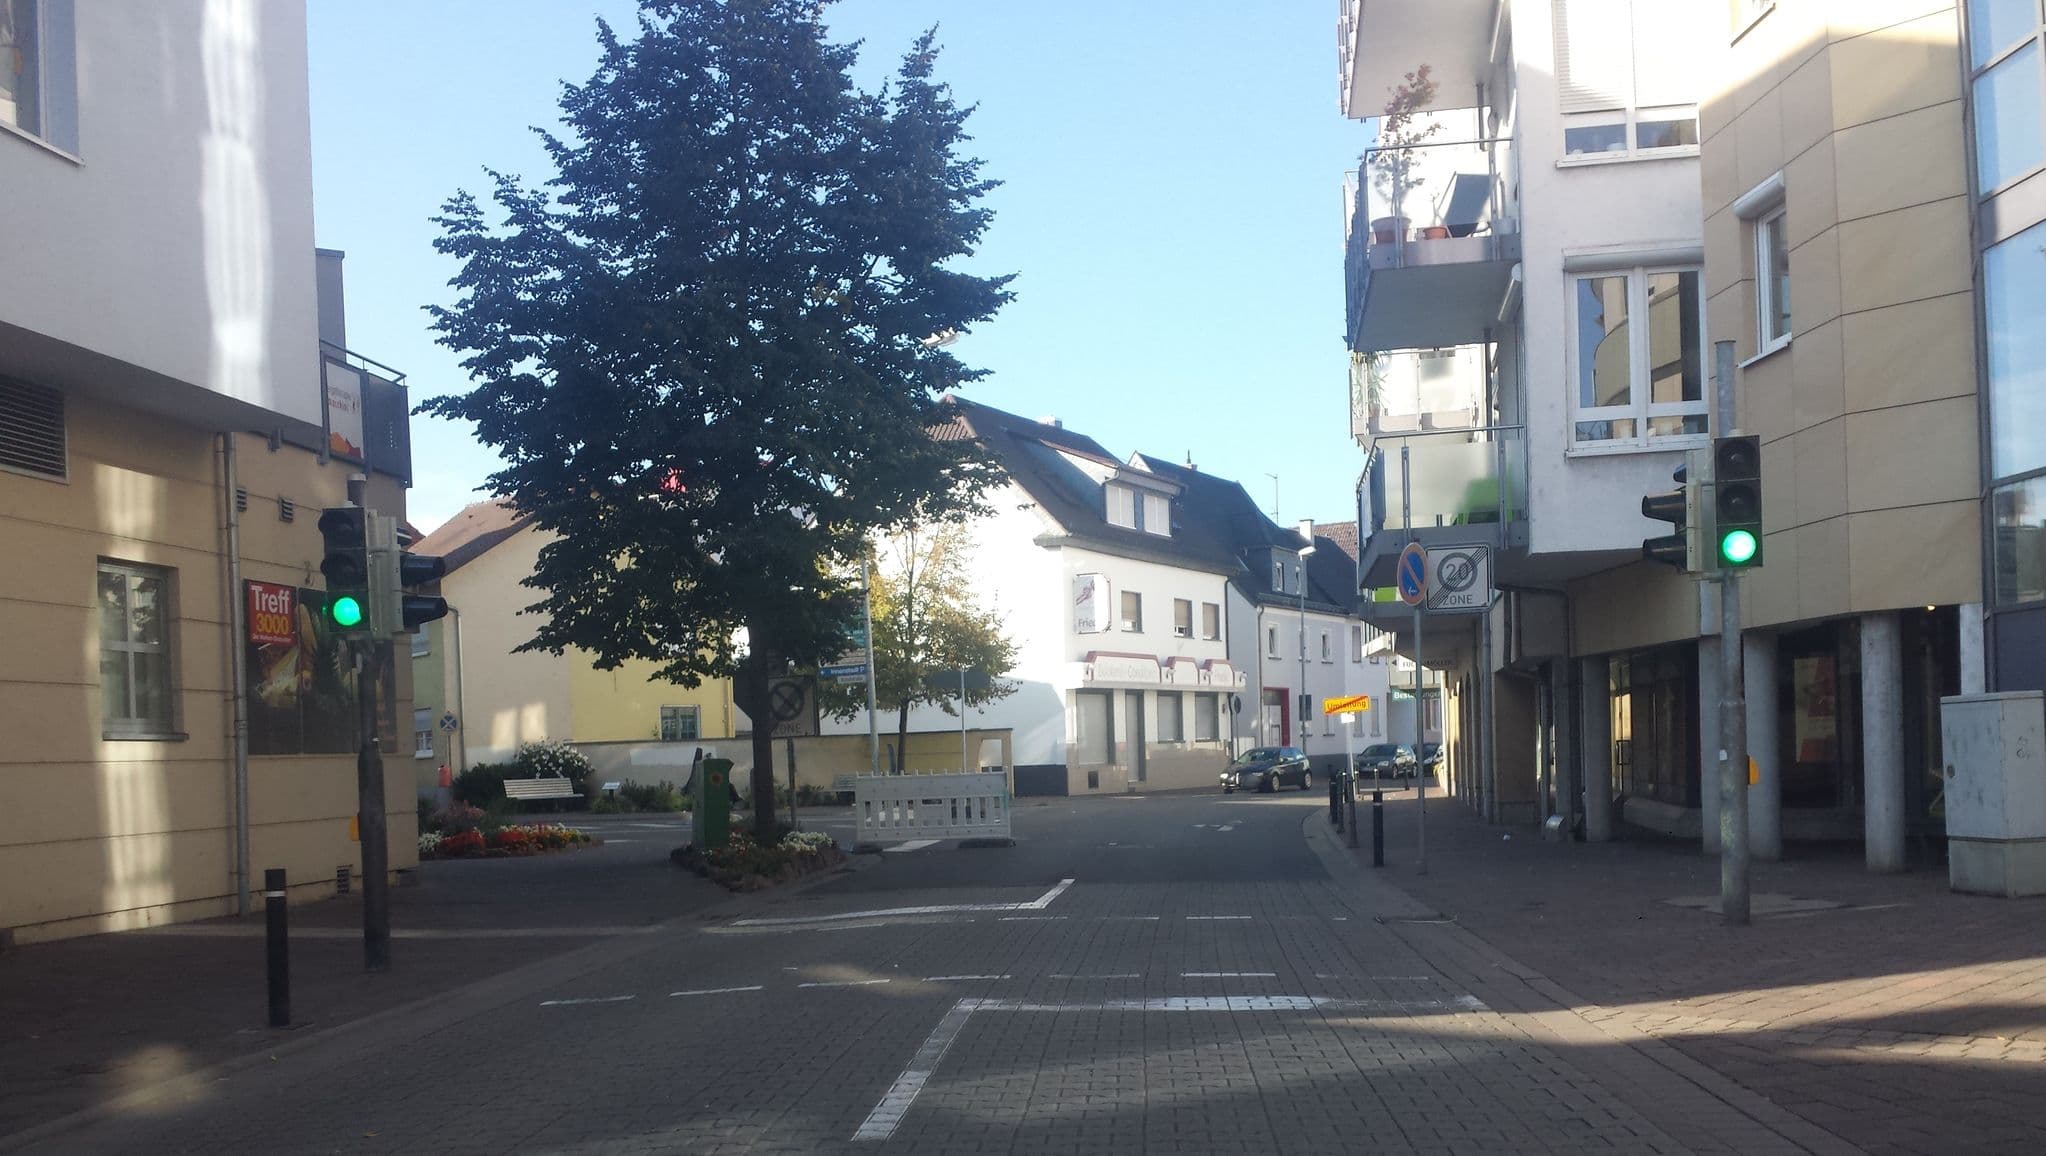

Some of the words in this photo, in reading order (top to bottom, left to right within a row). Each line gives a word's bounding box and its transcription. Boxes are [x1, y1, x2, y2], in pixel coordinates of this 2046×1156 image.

[1446, 563, 1469, 581] 20
[251, 585, 289, 614] Treff
[1443, 594, 1473, 606] ZONE
[256, 613, 289, 635] 3000
